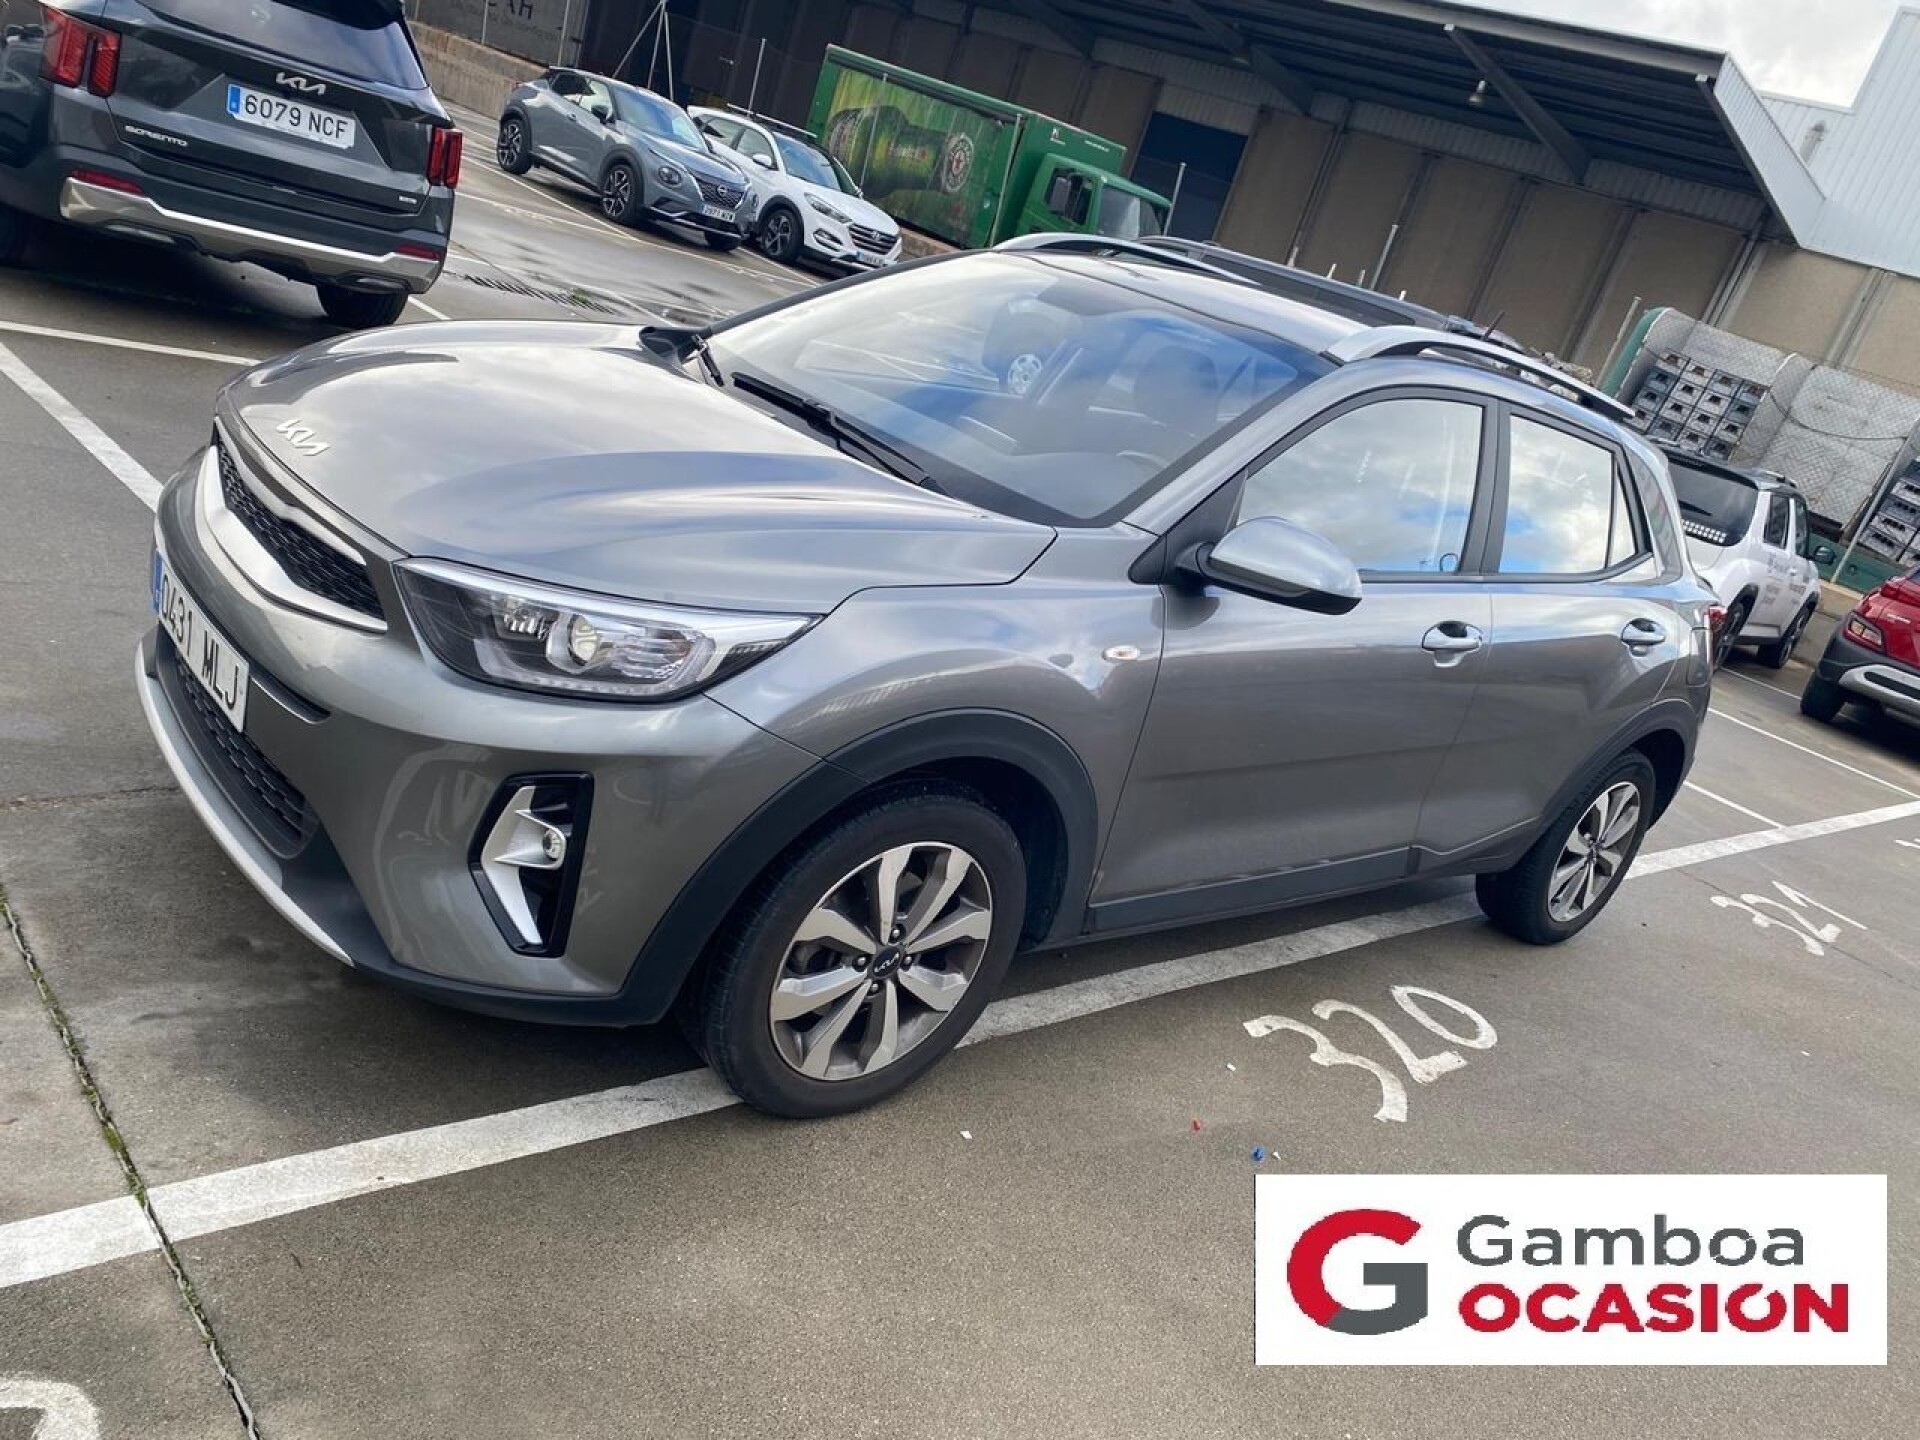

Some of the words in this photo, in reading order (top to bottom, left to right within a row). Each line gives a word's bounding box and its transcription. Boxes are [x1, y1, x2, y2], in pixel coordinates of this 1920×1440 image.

[125, 125, 188, 147] SORENTO
[244, 94, 301, 127] 6079
[308, 110, 349, 139] NCF
[161, 573, 193, 658] 0431
[202, 629, 240, 711] MLJ
[1710, 880, 1868, 957] 321
[1243, 985, 1498, 1123] 320
